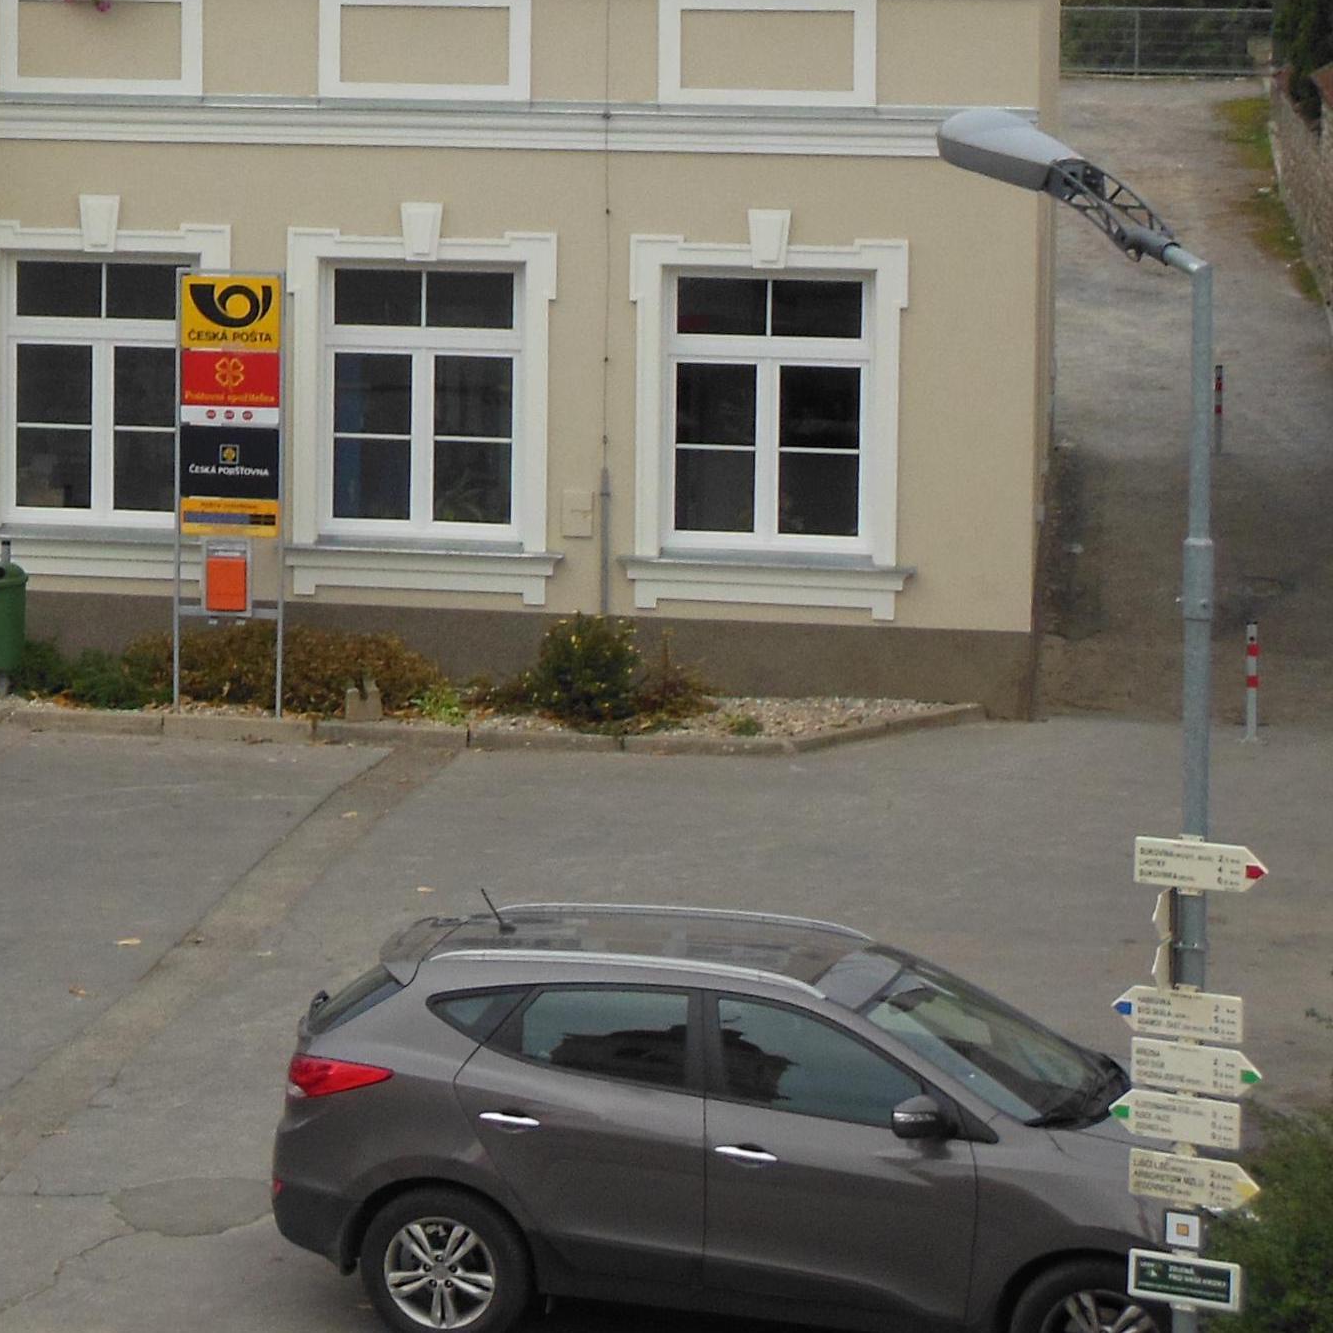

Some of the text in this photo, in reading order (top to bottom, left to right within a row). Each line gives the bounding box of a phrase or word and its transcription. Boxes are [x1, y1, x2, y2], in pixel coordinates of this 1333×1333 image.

[188, 328, 273, 343] ČESKÁ POŠTA
[188, 463, 217, 474] ČESKÁ
